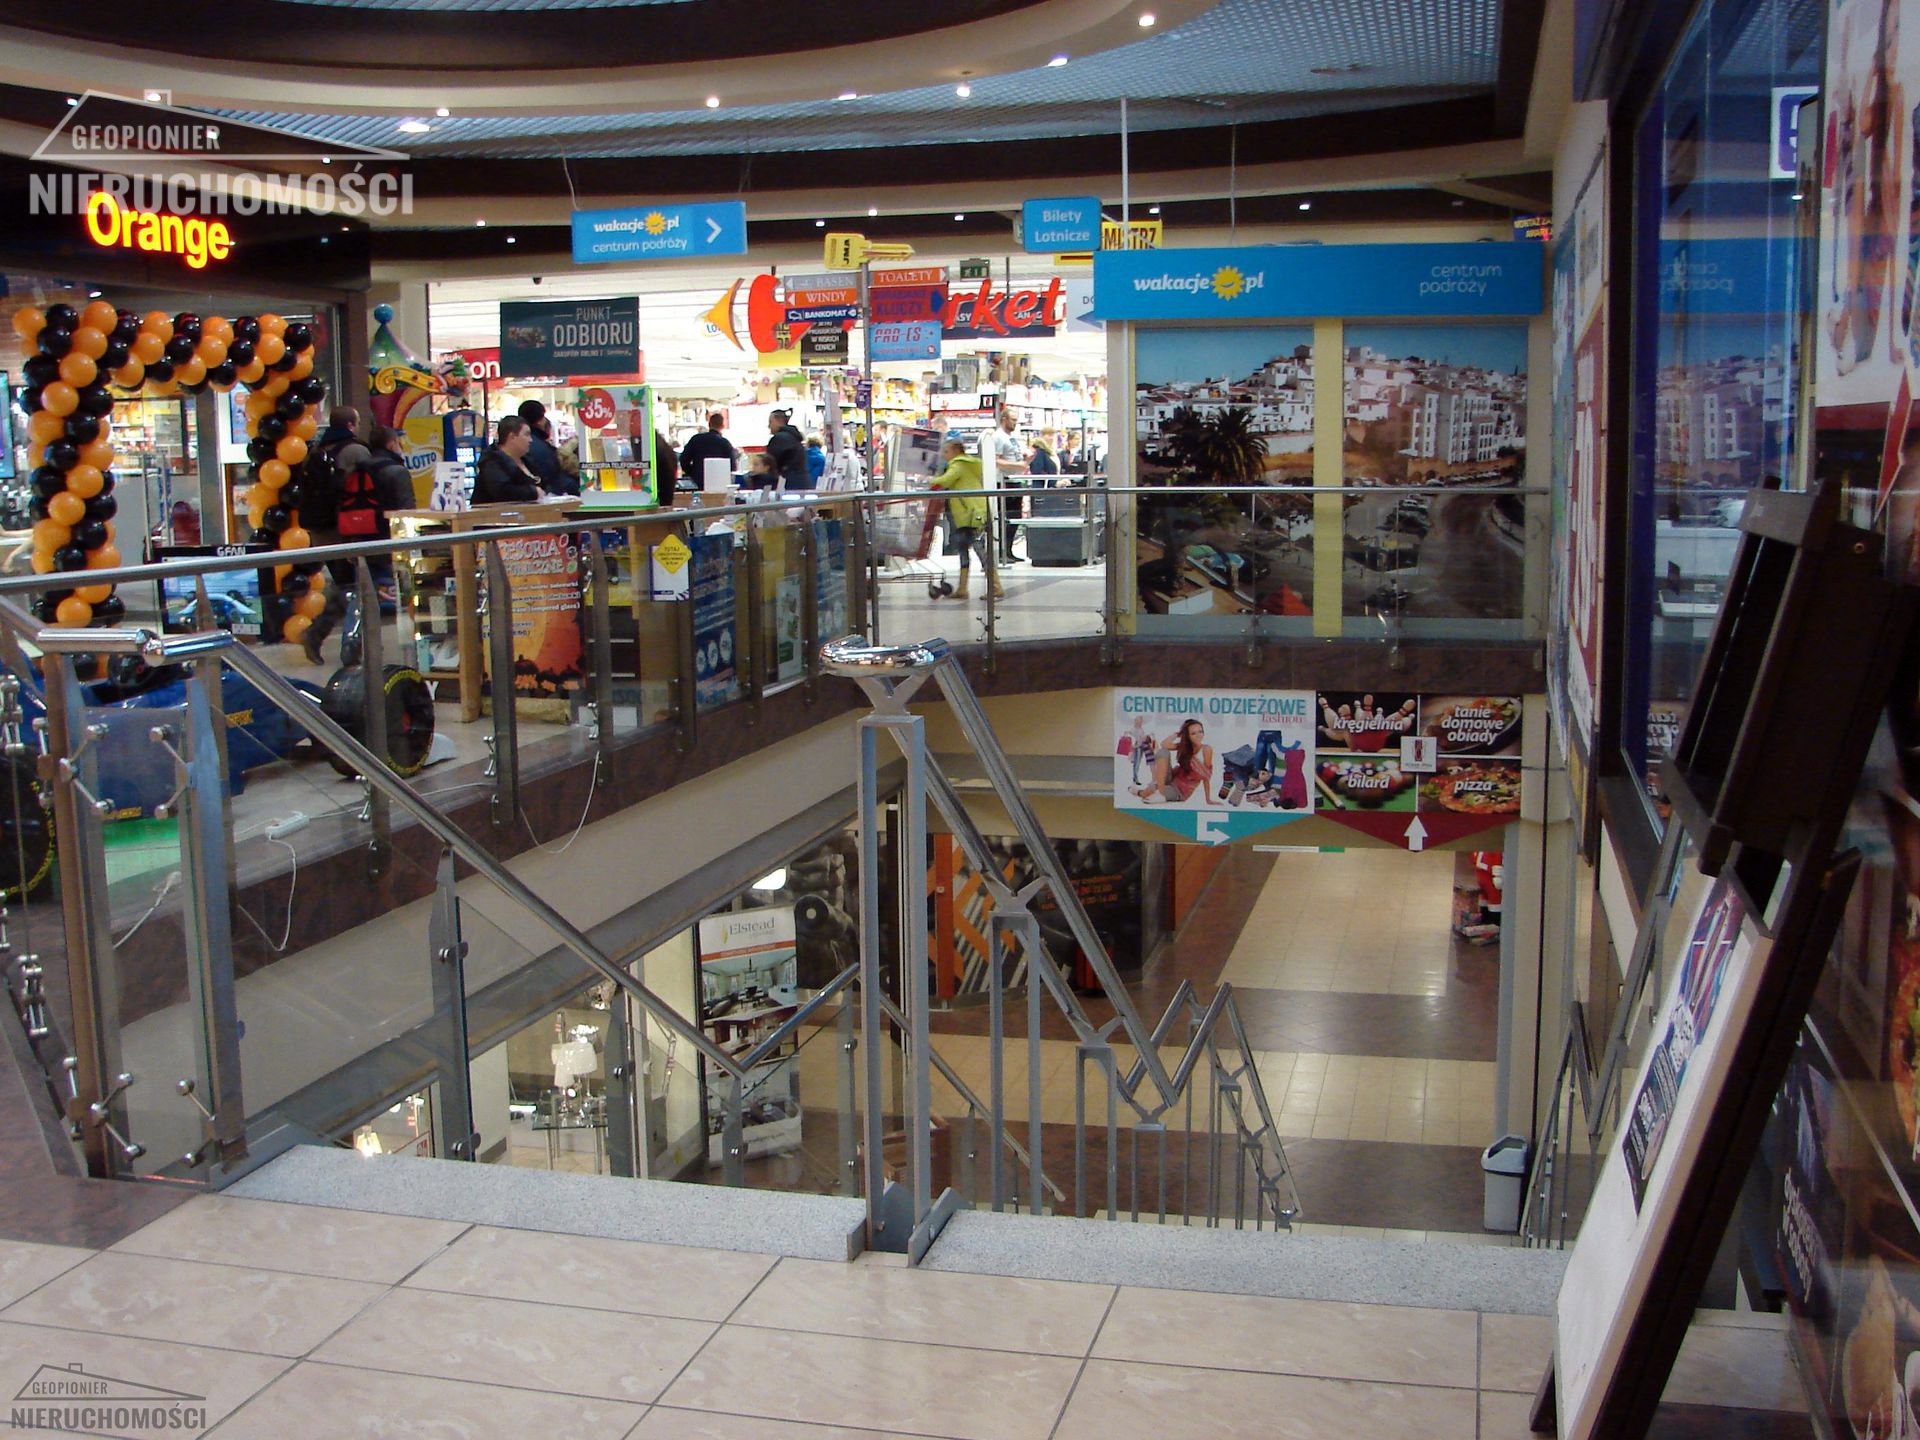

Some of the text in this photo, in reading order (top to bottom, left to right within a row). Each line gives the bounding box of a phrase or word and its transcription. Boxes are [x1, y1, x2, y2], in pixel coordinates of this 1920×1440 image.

[1042, 208, 1082, 224] Bilety
[87, 191, 231, 269] Orange
[1034, 229, 1090, 243] Lotnicze
[592, 238, 688, 253] centrum podróży
[878, 271, 933, 283] TOALETY
[1430, 264, 1503, 278] centrum
[816, 277, 854, 287] BASEN
[1419, 278, 1487, 296] podróży
[806, 291, 847, 303] WINDY
[575, 306, 611, 321] PUNKT
[804, 309, 848, 319] BANKOMAT
[553, 322, 633, 347] ODBIORU
[580, 397, 613, 419] -35%
[405, 451, 437, 470] LOTTO
[1122, 694, 1307, 716] CENTRUM ODZIEŻOWE
[1454, 704, 1491, 719] tanie
[1333, 716, 1403, 733] kręgielnia
[1441, 716, 1504, 730] domowe
[1447, 729, 1498, 745] obiady
[1348, 773, 1390, 790] bilard
[1454, 779, 1492, 794] pizza
[729, 917, 775, 936] Elstead
